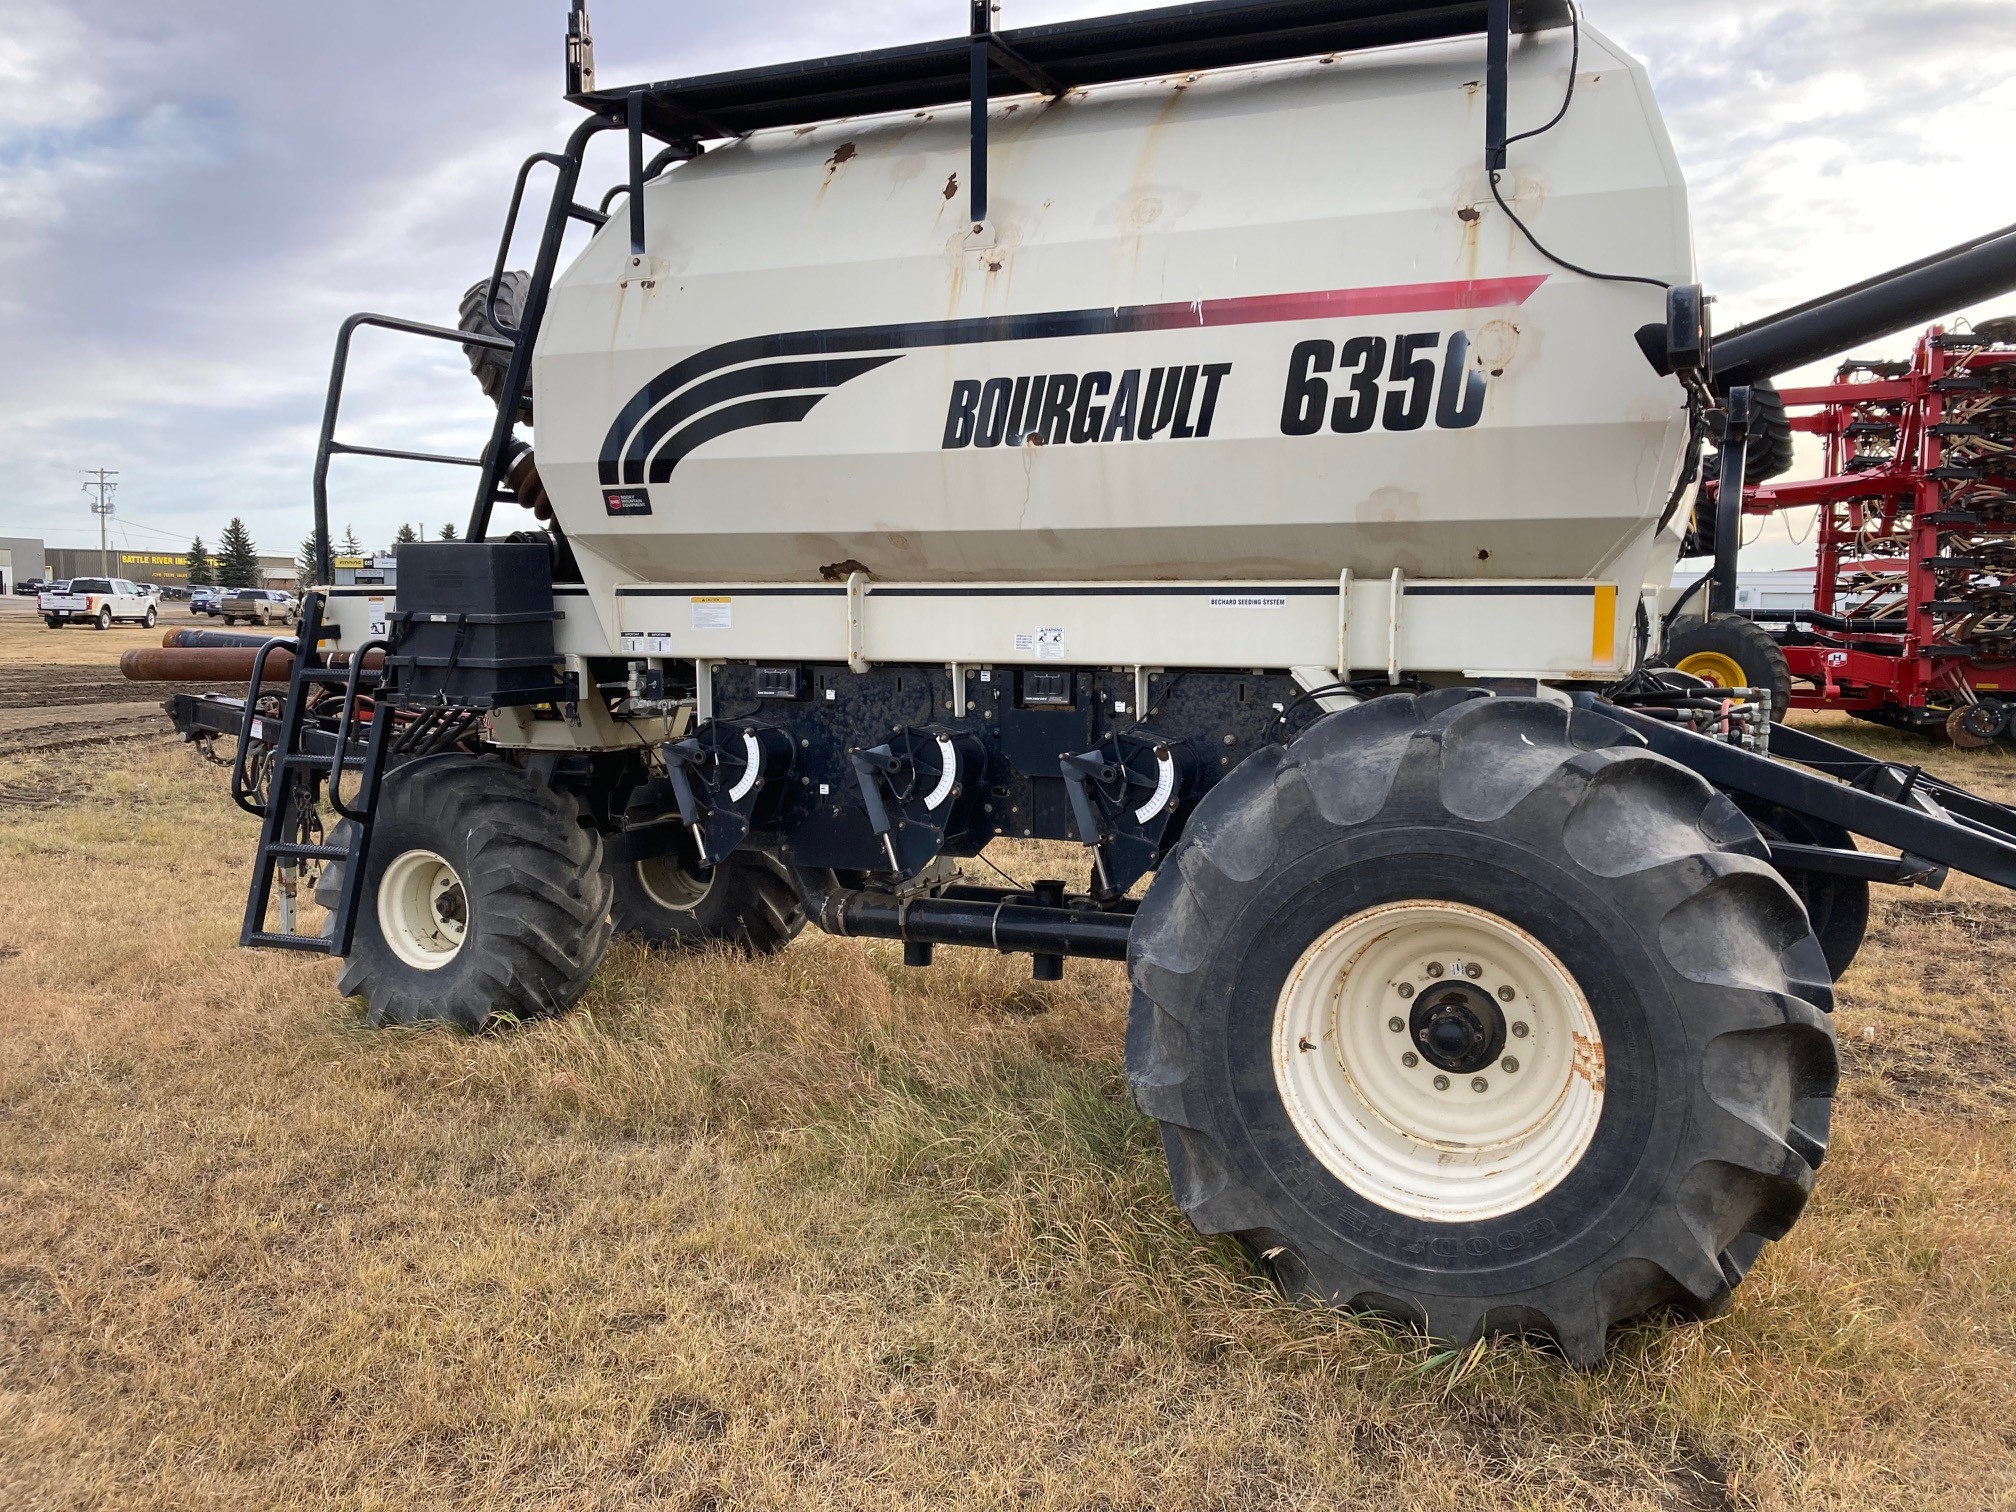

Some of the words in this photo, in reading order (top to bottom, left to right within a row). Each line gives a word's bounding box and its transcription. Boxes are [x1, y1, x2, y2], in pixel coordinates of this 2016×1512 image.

[942, 363, 1232, 449] BOURGAULT
[1280, 331, 1487, 436] 6350
[122, 555, 150, 564] BATTLE
[152, 556, 173, 565] RIVER
